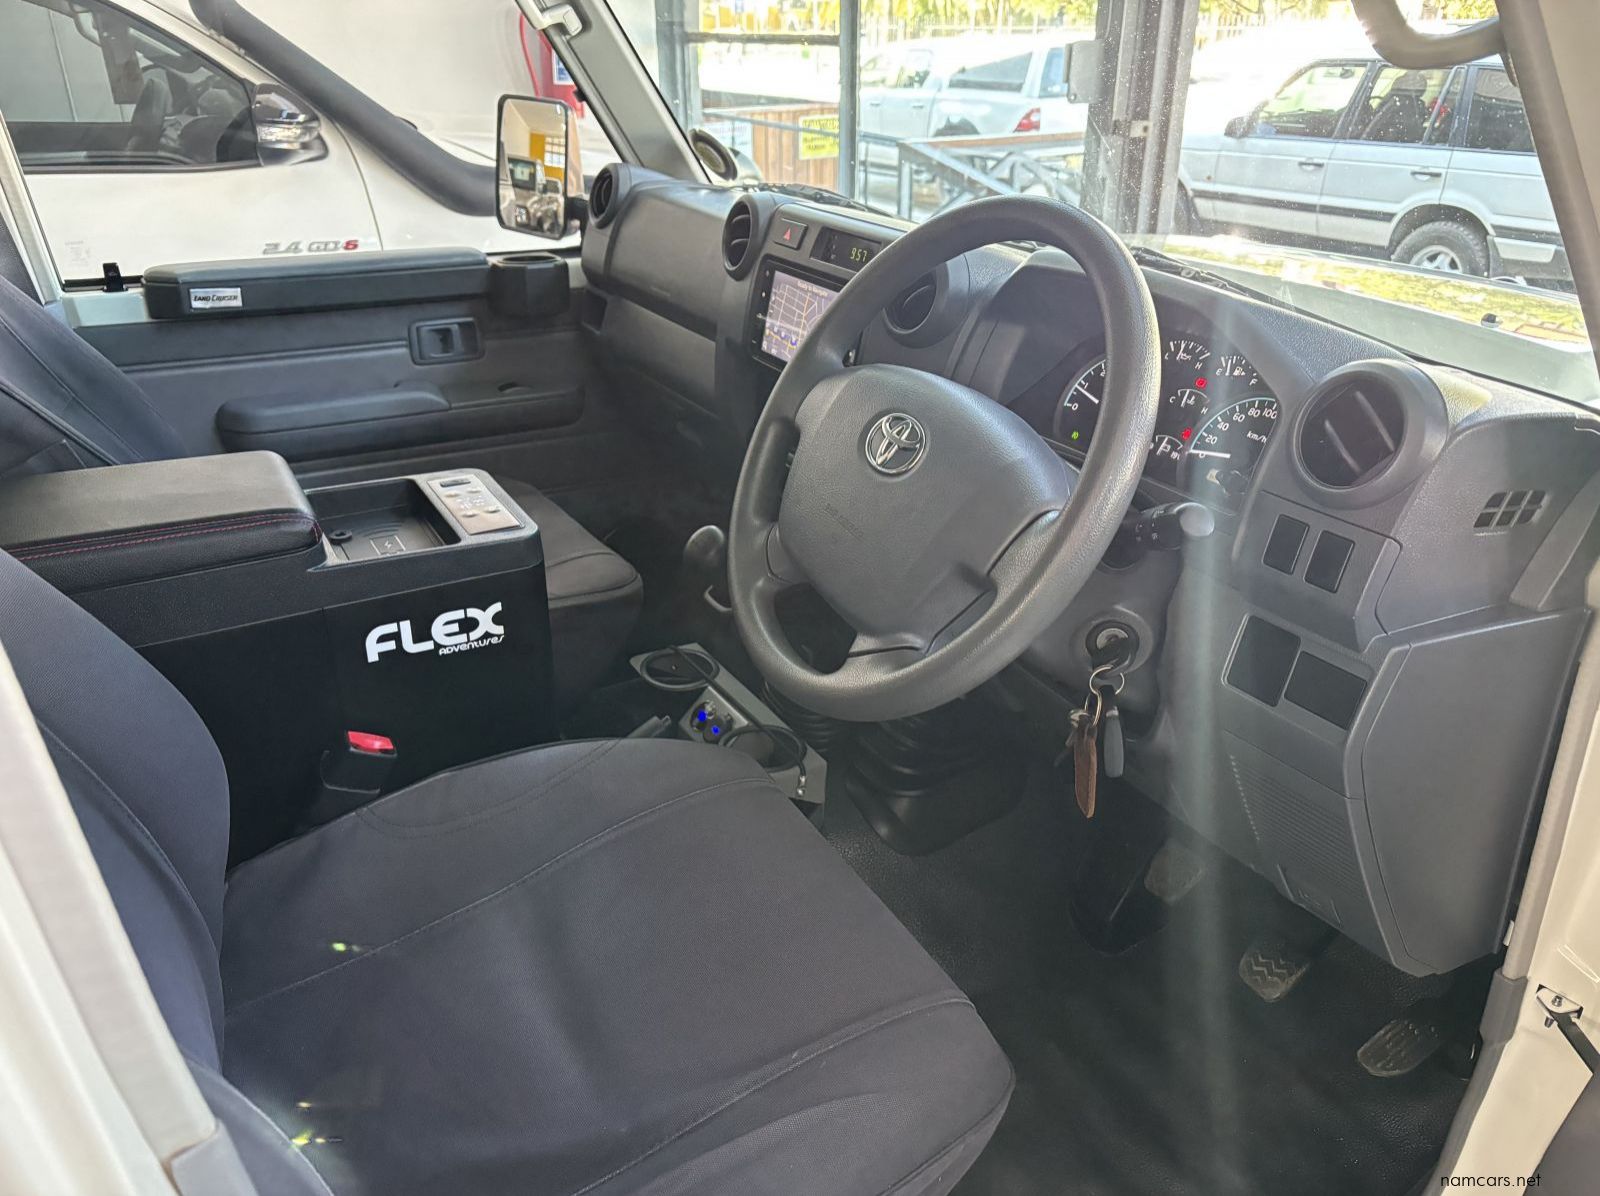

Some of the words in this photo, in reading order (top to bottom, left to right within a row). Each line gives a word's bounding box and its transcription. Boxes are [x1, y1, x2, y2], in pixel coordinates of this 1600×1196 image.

[1215, 368, 1223, 376] E
[1248, 378, 1258, 386] F
[1232, 412, 1246, 423] 60
[1247, 407, 1261, 418] 80
[1262, 407, 1278, 419] 100
[1217, 420, 1230, 432] 40
[1205, 434, 1218, 445] 20
[1246, 430, 1268, 444] km/h
[365, 601, 505, 663] FLEX
